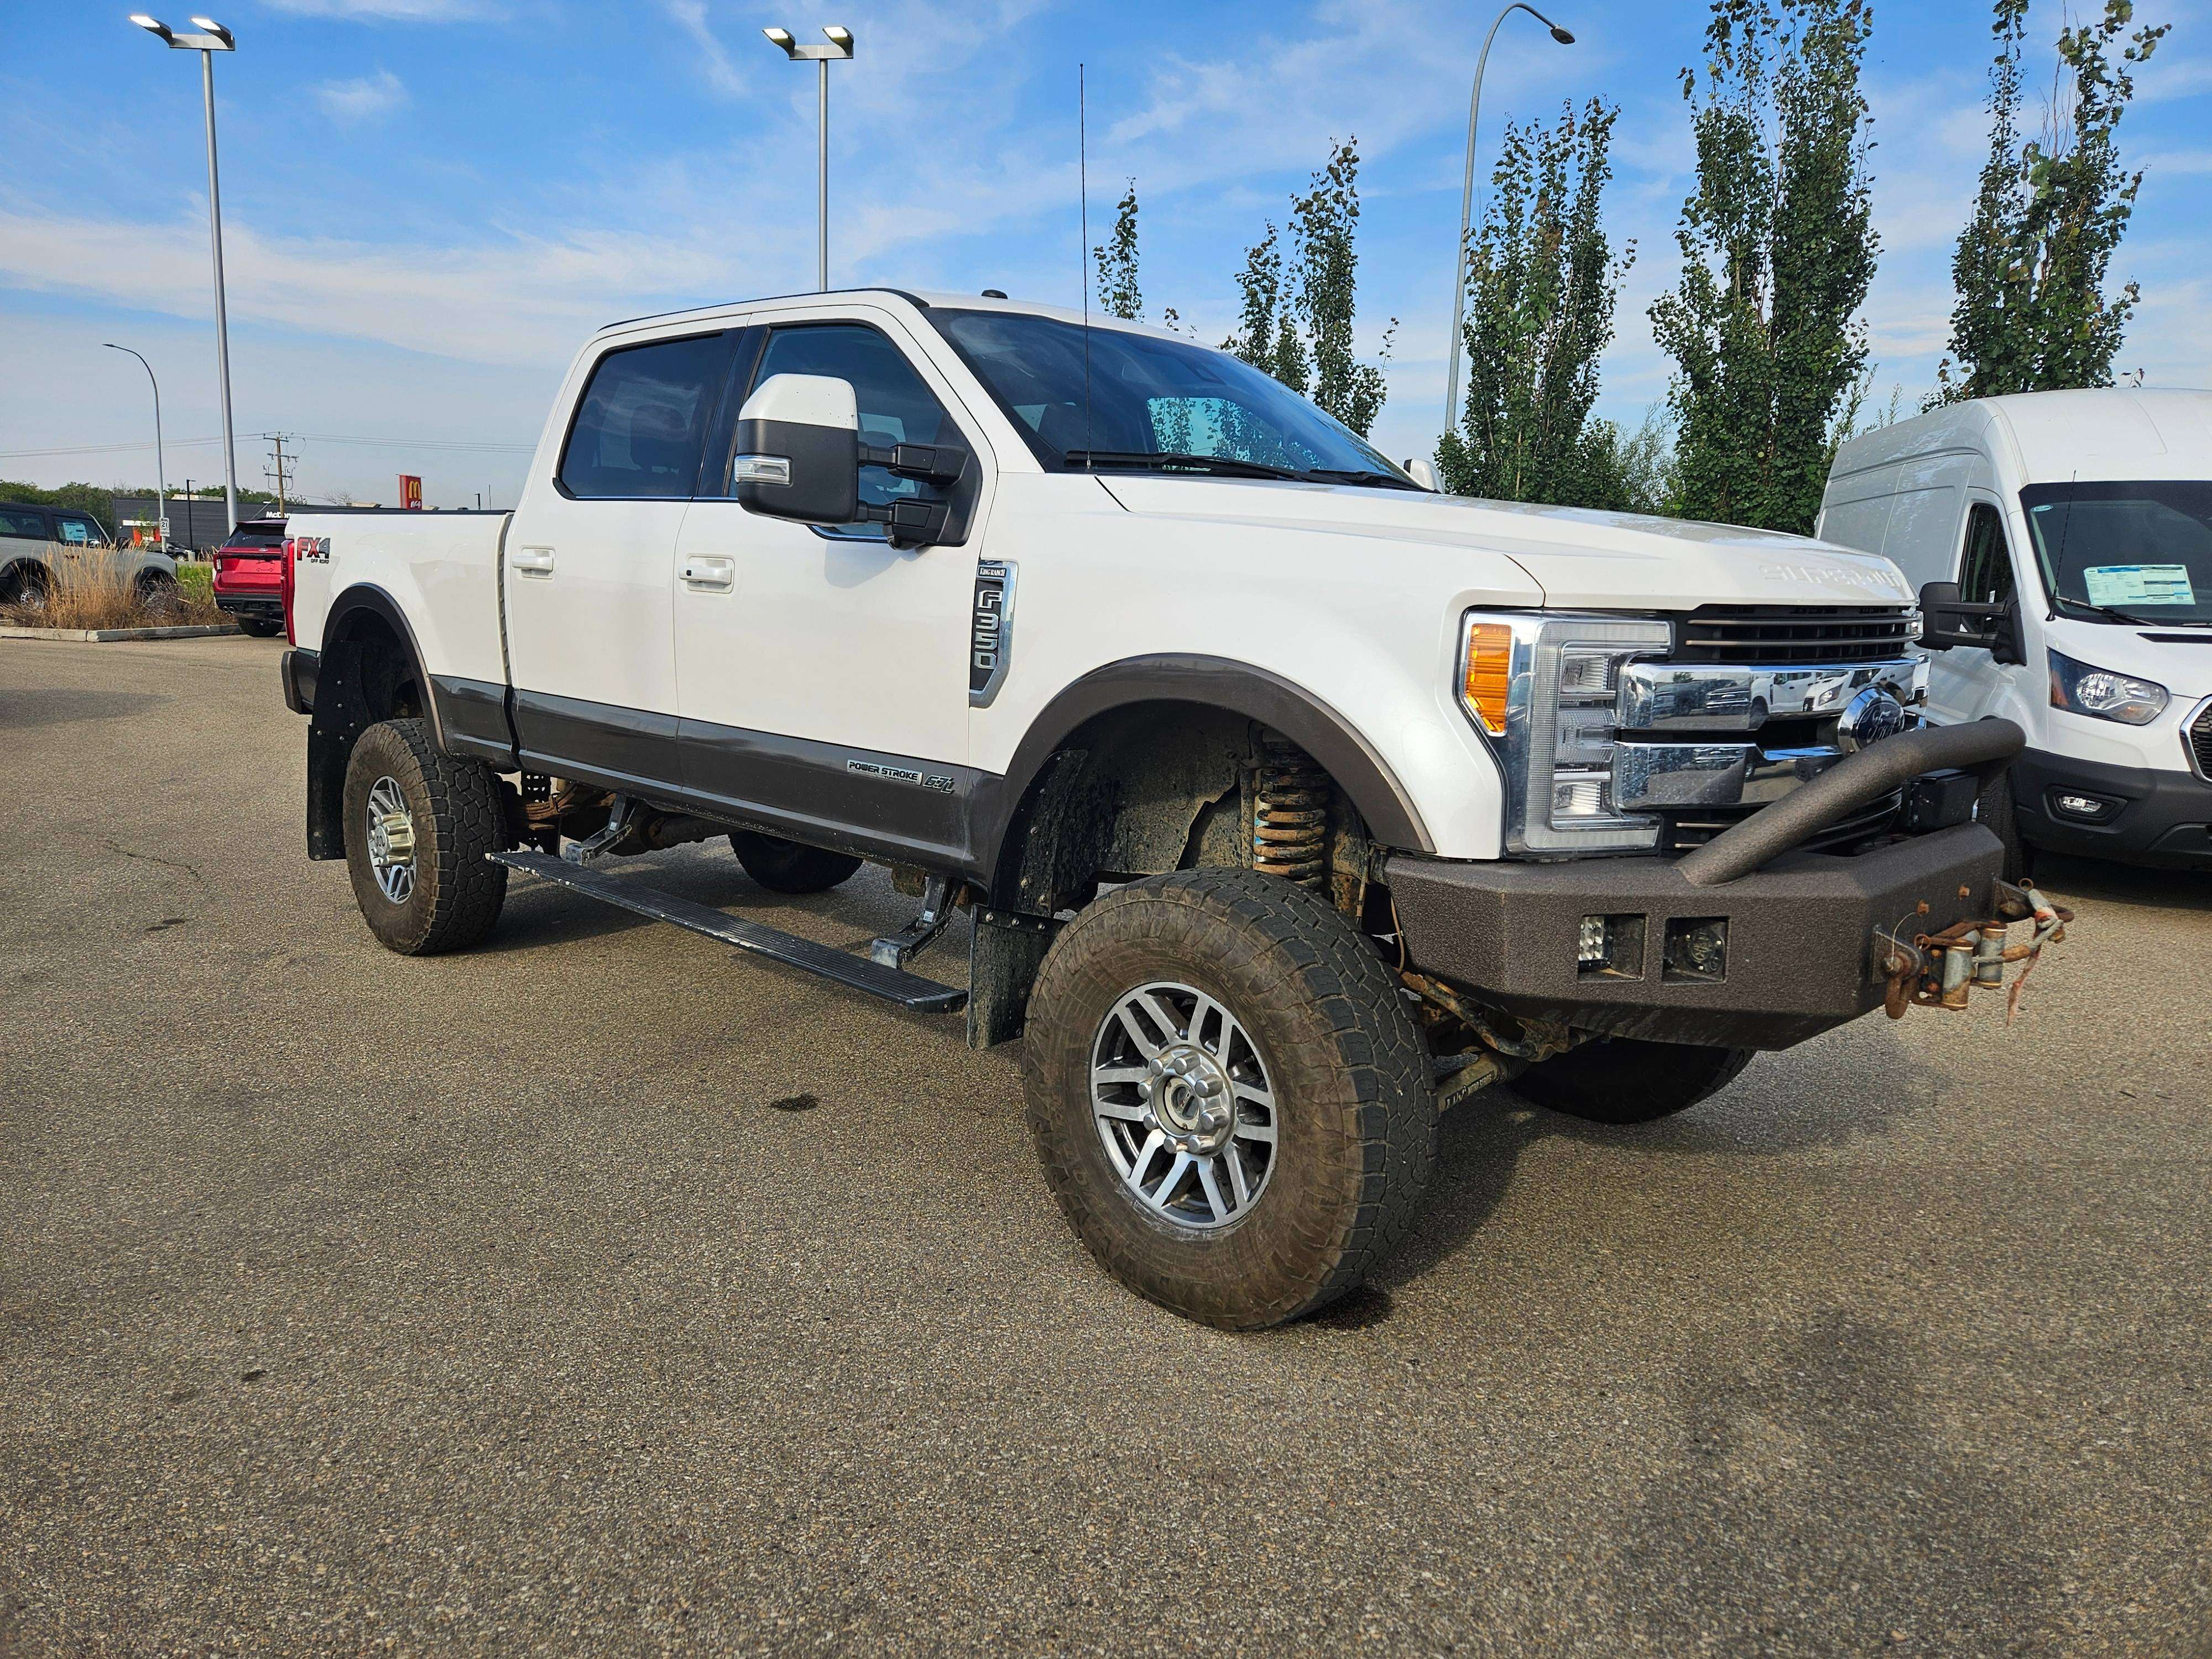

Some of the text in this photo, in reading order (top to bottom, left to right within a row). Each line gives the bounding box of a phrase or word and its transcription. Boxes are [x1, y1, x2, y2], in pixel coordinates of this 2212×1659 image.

[297, 536, 331, 561] FX4
[979, 567, 1005, 577] KING RANCH
[849, 761, 880, 774] POWER
[881, 767, 919, 781] STROKE
